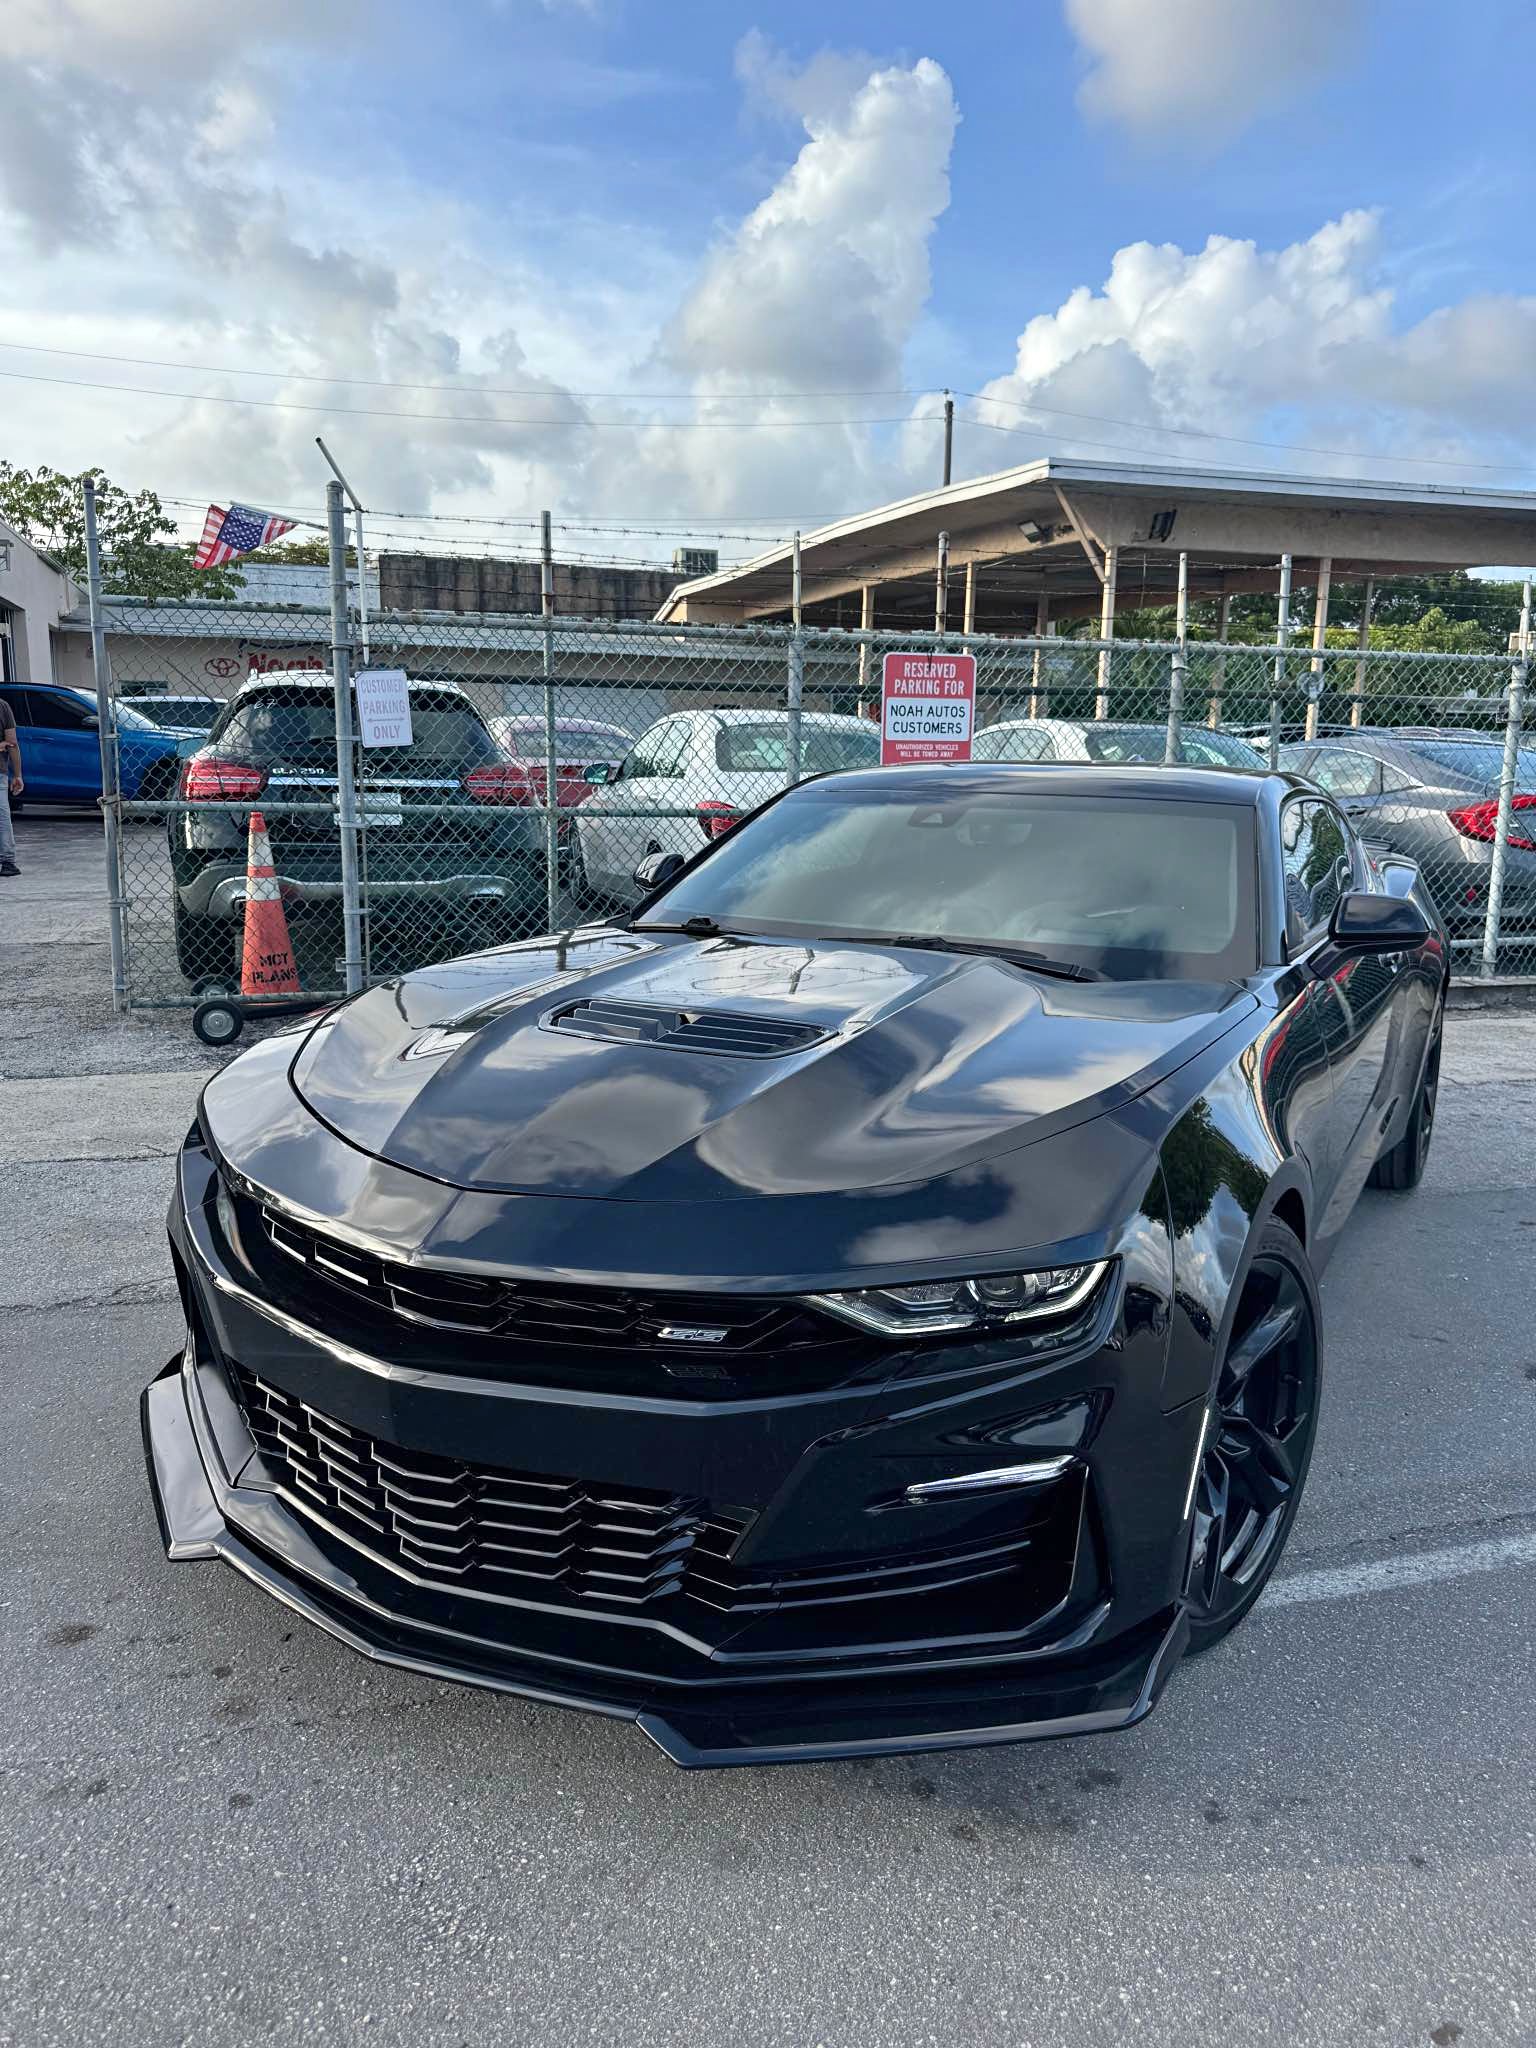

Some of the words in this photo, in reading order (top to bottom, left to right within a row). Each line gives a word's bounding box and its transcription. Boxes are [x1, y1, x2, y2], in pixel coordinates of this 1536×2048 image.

[904, 662, 956, 678] RESERVED
[361, 679, 405, 694] CUSTOMER
[894, 679, 940, 695] PARKING
[944, 680, 964, 695] FOR
[363, 700, 407, 715] PARKING
[890, 705, 923, 717] NOAH
[927, 706, 966, 718] AUTOS
[373, 725, 400, 739] ONLY
[893, 722, 962, 734] CUSTOMERS
[896, 743, 933, 751] UNAUTHORIZED
